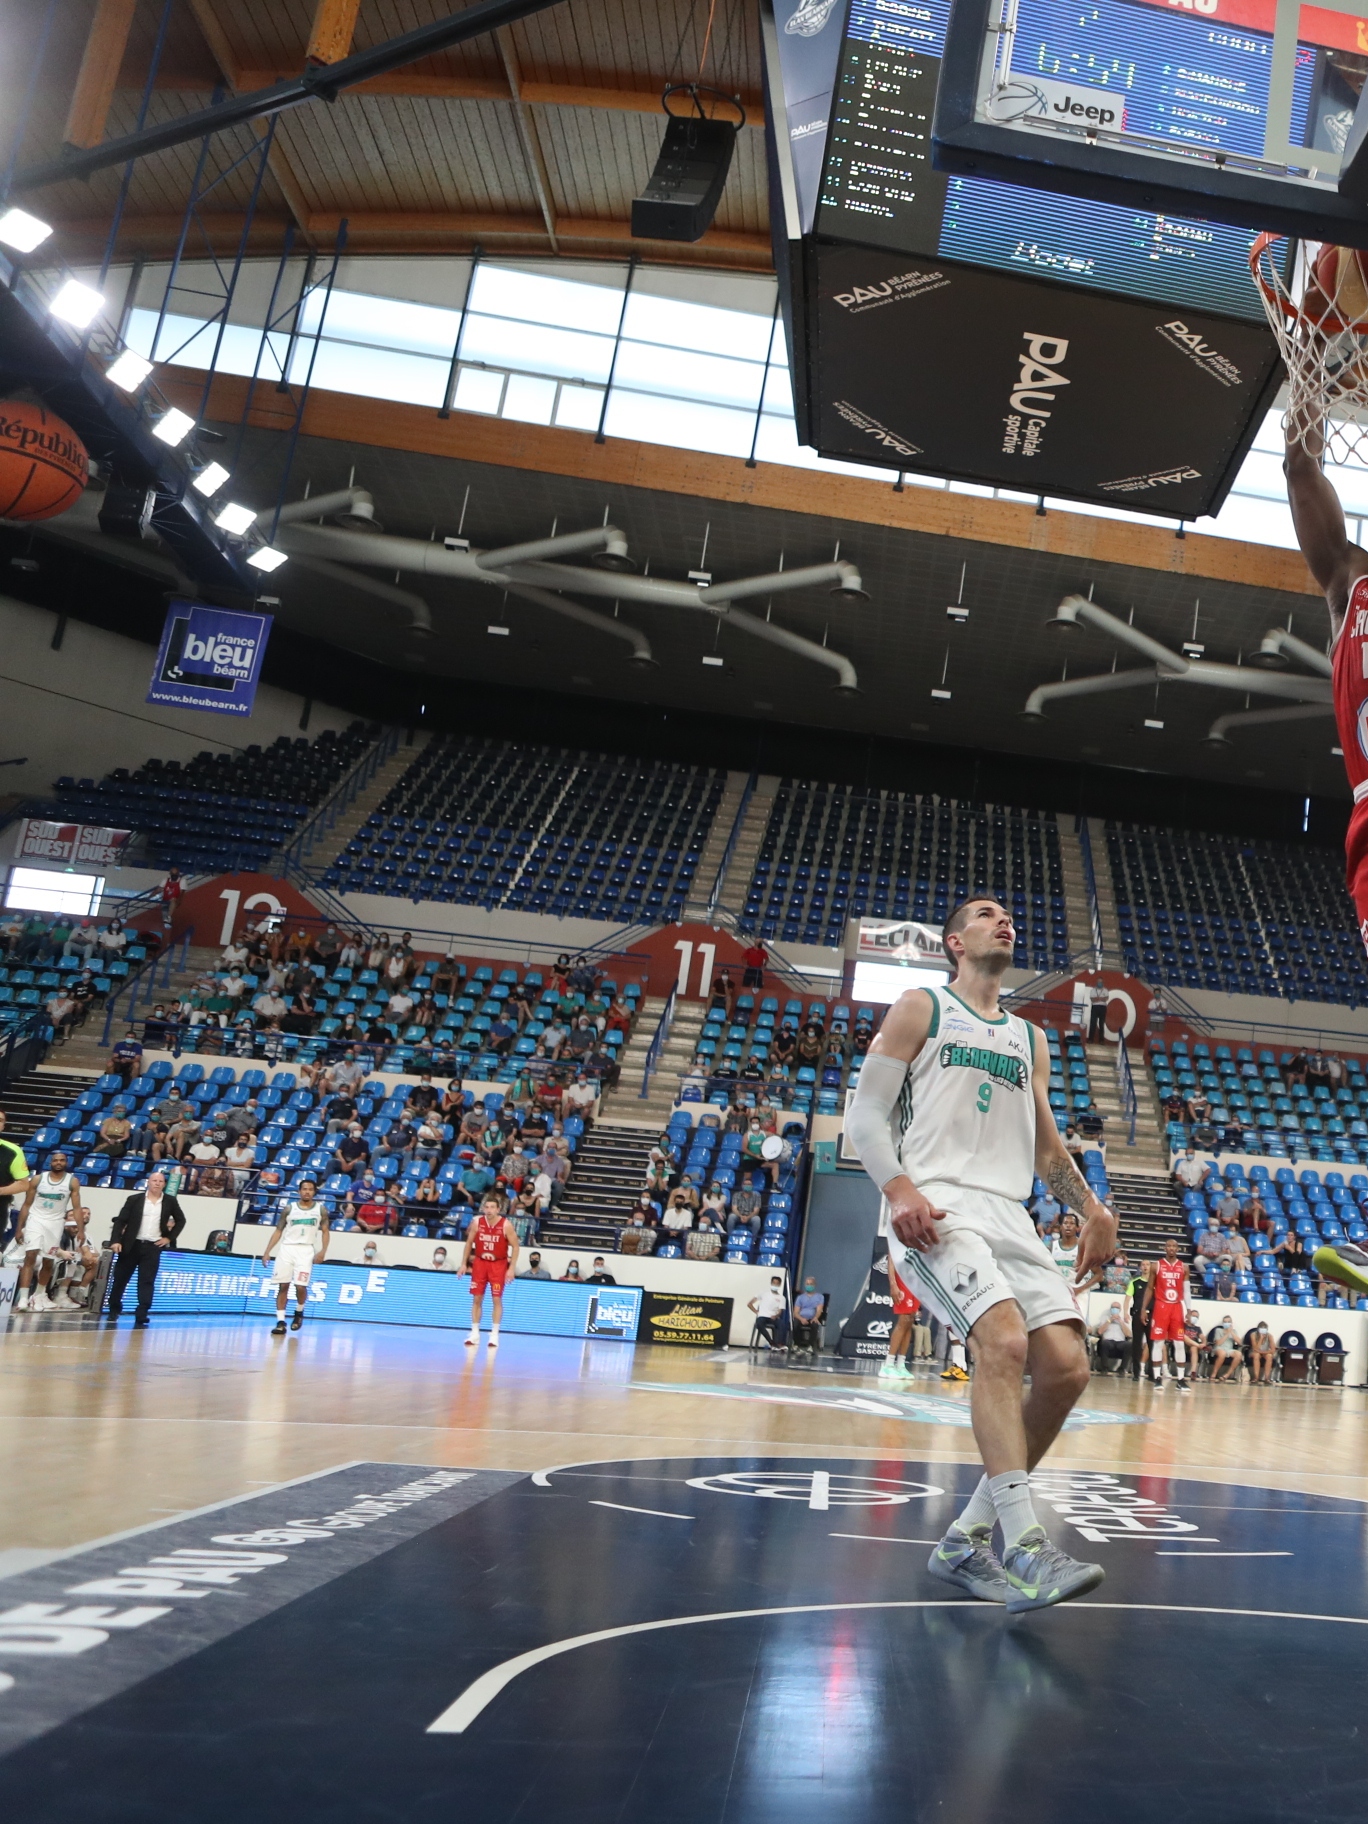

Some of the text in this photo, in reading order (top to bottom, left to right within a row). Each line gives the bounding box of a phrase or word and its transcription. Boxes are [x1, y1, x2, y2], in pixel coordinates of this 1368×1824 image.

[1053, 96, 1115, 126] Jeep
[889, 271, 921, 286] BÉARN
[895, 271, 943, 292] PYRÉNÉES
[833, 282, 892, 308] PAU
[850, 279, 951, 313] Communauté d'Agglomération
[1164, 320, 1217, 357] PAU
[1155, 326, 1231, 387] Communauté d'Agglomération
[1215, 355, 1242, 375] BÉARN
[1010, 332, 1071, 418] PAU
[1206, 358, 1242, 385] PYRÉNÉES
[865, 427, 917, 456] PAU
[1002, 414, 1021, 454] sportive
[1022, 419, 1046, 457] Capitale
[1147, 469, 1202, 487] PAU
[183, 633, 254, 668] bleu
[217, 633, 255, 647] france
[213, 664, 248, 678] béarn
[152, 692, 248, 712] www.bleubearn.fr
[27, 820, 60, 840] SUD
[81, 826, 114, 844] SUD
[24, 837, 73, 858] OUEST
[219, 889, 286, 945] 12
[674, 940, 716, 998] 11
[976, 1082, 993, 1113] 9
[160, 1272, 194, 1294] TOUS
[195, 1273, 218, 1295] LES
[961, 1282, 996, 1313] RENAULT
[658, 1317, 714, 1329] HARICHOURY
[856, 1341, 891, 1350] PYRÉNÉE
[64, 1549, 289, 1598] PAU
